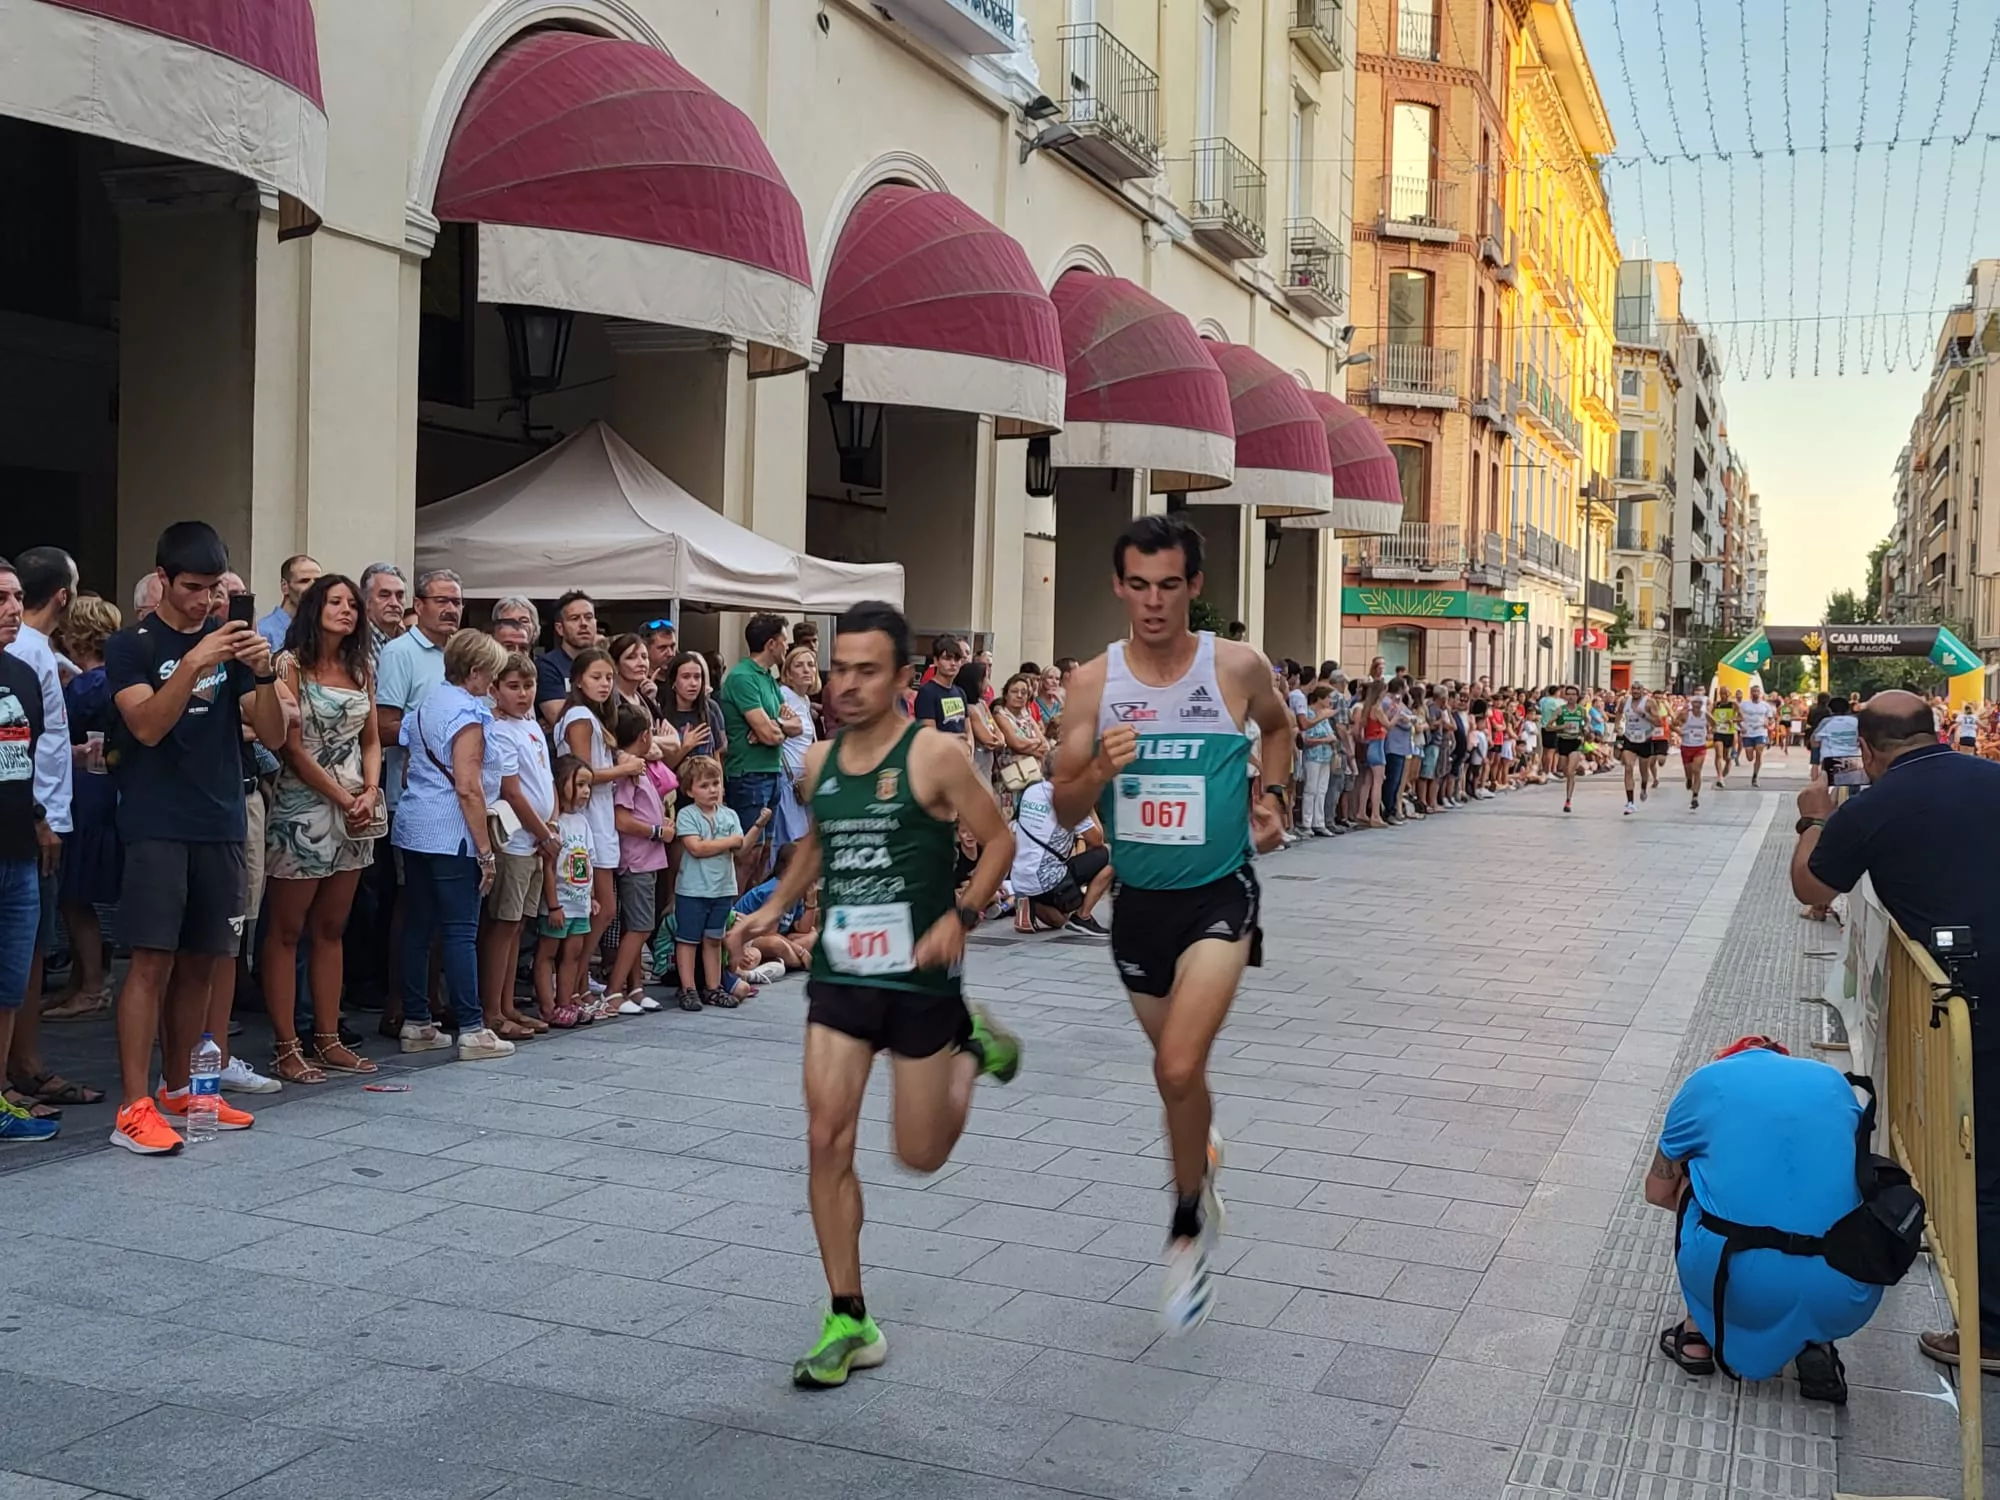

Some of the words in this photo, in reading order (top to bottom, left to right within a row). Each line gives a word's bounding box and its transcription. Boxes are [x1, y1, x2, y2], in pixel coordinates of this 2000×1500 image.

[1829, 633, 1860, 644] CAJA
[1861, 633, 1901, 645] RURAL
[1837, 645, 1850, 653] DE
[1852, 643, 1893, 653] ARAGÓN
[1134, 739, 1206, 760] TLEET
[1140, 800, 1188, 828] 067
